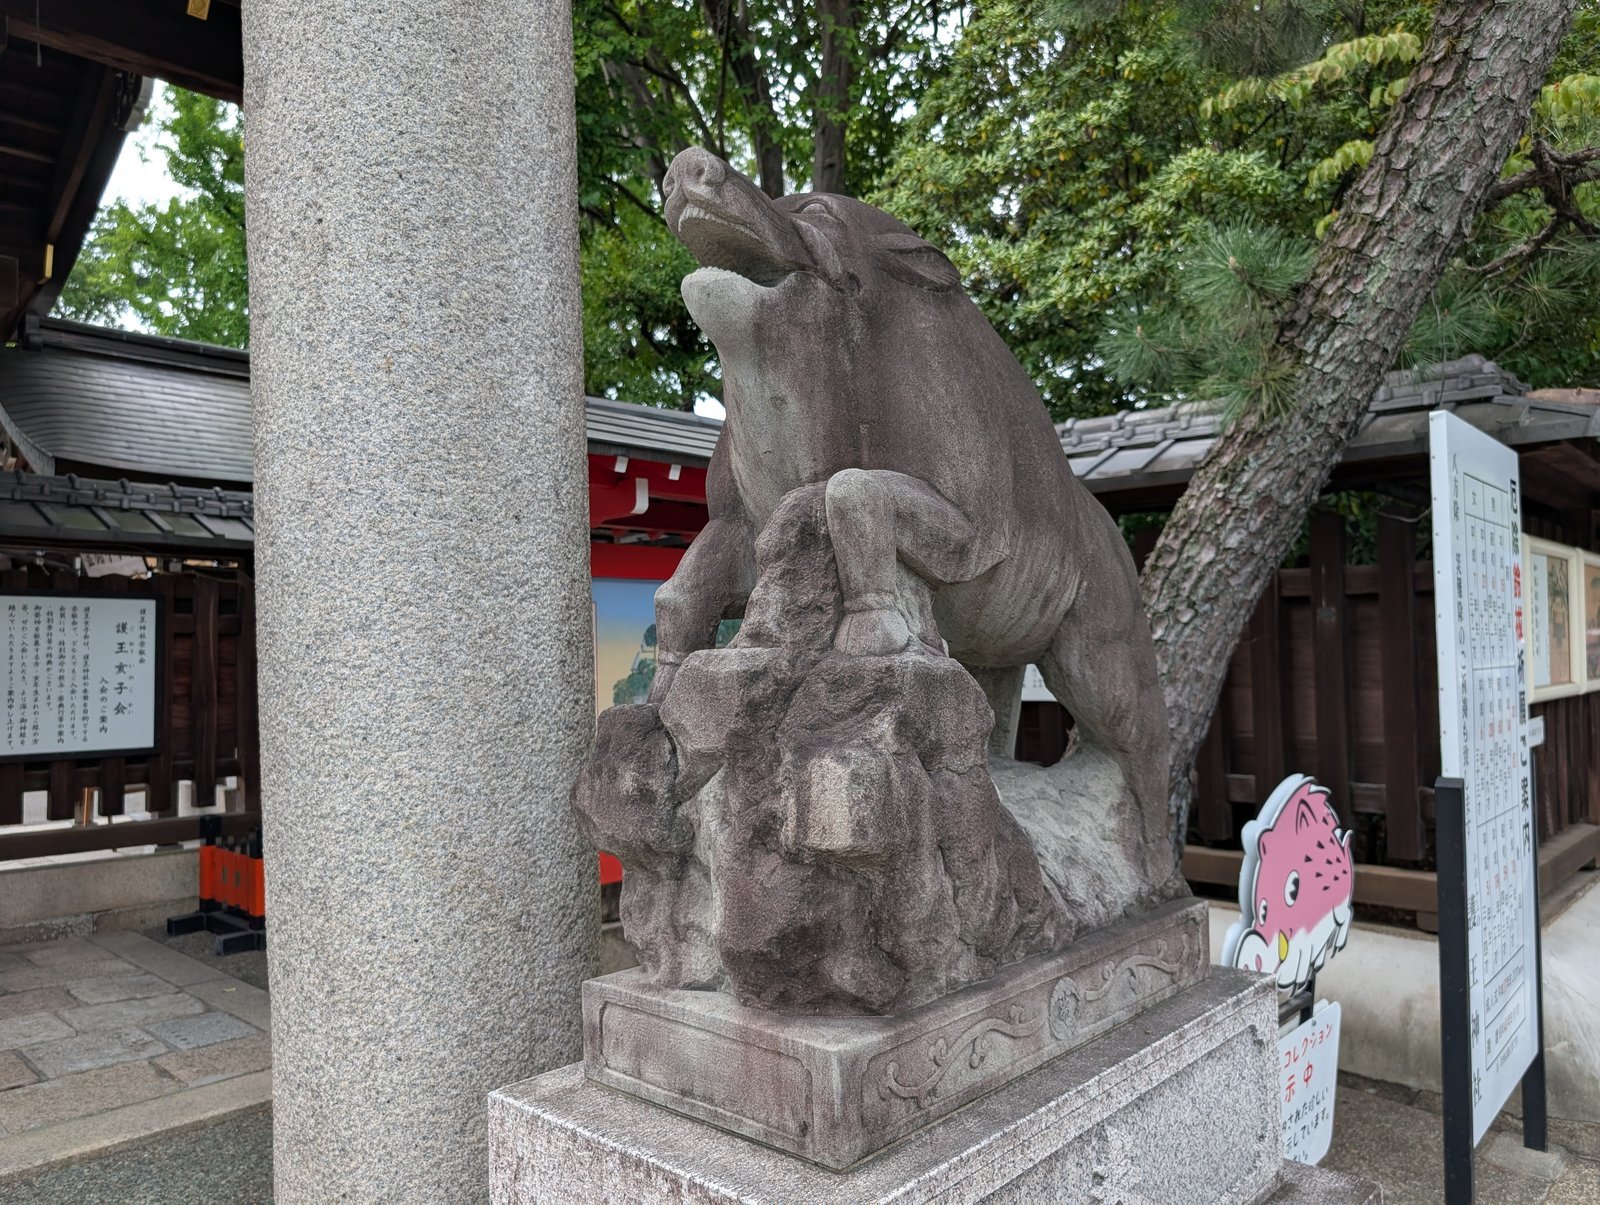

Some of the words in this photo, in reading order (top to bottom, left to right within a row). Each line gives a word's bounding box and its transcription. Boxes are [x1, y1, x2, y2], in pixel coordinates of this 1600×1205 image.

[113, 621, 129, 716] 護王亥子会
[99, 676, 109, 734] 入会のご案内
[1279, 1023, 1333, 1071] コレクション
[1281, 1107, 1329, 1154] 示しています。
